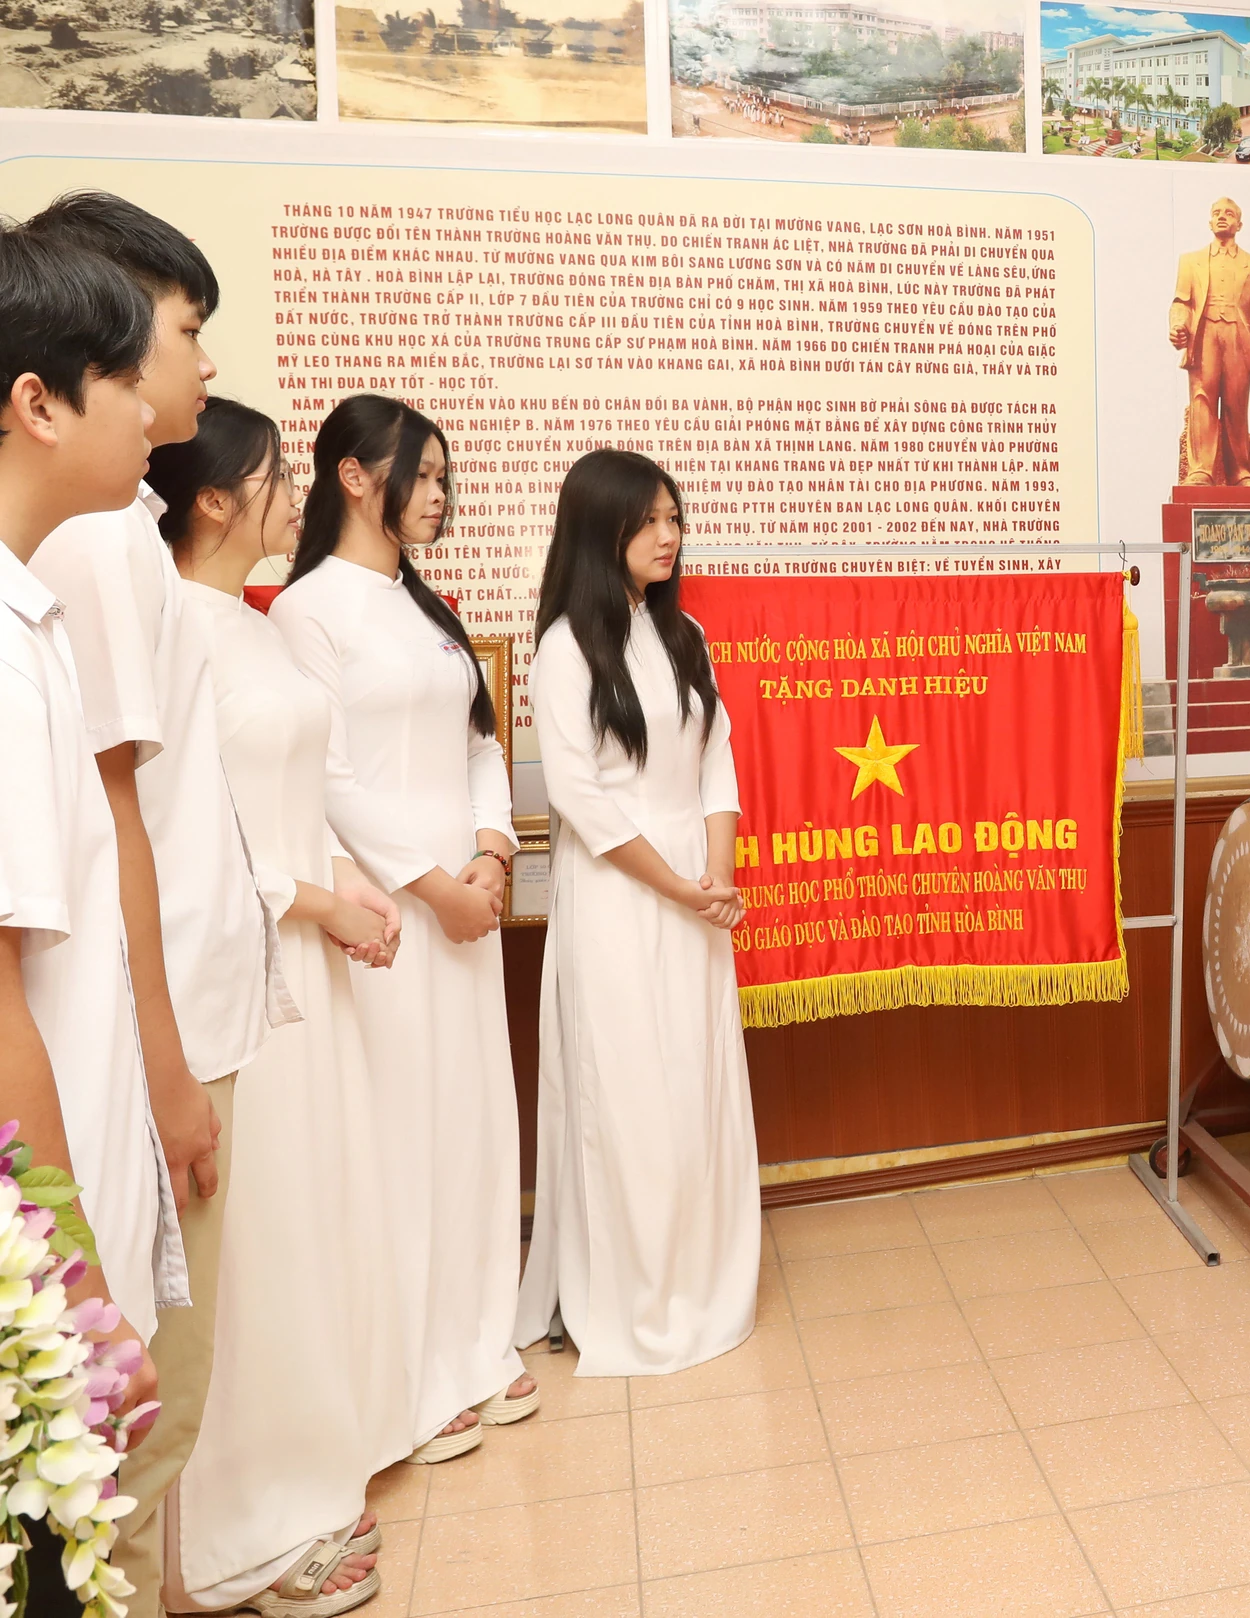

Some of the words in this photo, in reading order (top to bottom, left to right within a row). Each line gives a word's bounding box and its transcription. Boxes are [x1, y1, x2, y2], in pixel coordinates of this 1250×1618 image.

[282, 201, 333, 218] THÁNG
[337, 205, 355, 219] 10
[359, 203, 393, 219] NĂM
[397, 206, 433, 220] 1947
[436, 205, 495, 222] TRƯỜNG
[498, 205, 530, 223] TIỂU
[534, 210, 563, 226] HỌC
[566, 211, 593, 226] LẠC
[597, 212, 634, 226] LONG
[637, 211, 675, 228] QUÂN
[678, 212, 697, 228] ĐÃ
[701, 215, 719, 229] RA
[722, 215, 746, 230] ĐỜI
[749, 217, 771, 233] TẠI
[774, 216, 823, 233] MƯỜNG
[826, 220, 866, 235] VANG,
[869, 222, 894, 237] LẠC
[897, 223, 924, 237] SƠN
[927, 223, 953, 238] HOÀ
[956, 224, 991, 239] BÌNH.
[994, 225, 1023, 241] NĂM
[1026, 229, 1055, 242] 1951
[277, 372, 307, 390] VẪN
[310, 376, 333, 390] THI
[336, 376, 365, 390] ĐUA
[369, 376, 397, 389] DẠY
[400, 372, 425, 390] TỐT
[438, 376, 466, 392] HỌC
[469, 373, 499, 390] TỐT.
[676, 477, 722, 495] NHIỆM
[725, 480, 743, 495] VỤ
[747, 478, 775, 493] ĐÀO
[778, 479, 804, 495] TẠO
[807, 477, 845, 493] NHÂN
[848, 477, 870, 493] TÀI
[874, 479, 900, 493] CHO
[903, 479, 927, 495] ĐỊA
[930, 478, 988, 493] PHƯƠNG.
[991, 478, 1021, 492] NĂM
[1024, 480, 1060, 494] 1993,
[695, 520, 722, 535] VĂN
[725, 521, 756, 537] THỤ.
[759, 518, 777, 534] TỪ
[779, 519, 809, 534] NĂM
[812, 521, 839, 536] HỌC
[842, 521, 872, 534] 2001
[886, 520, 918, 533] 2002
[920, 516, 946, 534] ĐẾN
[949, 520, 979, 534] NAY,
[982, 518, 1009, 533] NHÀ
[1011, 517, 1060, 532] TRƯỜNG
[467, 562, 487, 581] CẢ
[707, 560, 749, 575] RIÊNG
[753, 557, 780, 574] CỦA
[784, 558, 837, 574] TRƯỜNG
[841, 558, 893, 573] CHUYÊN
[897, 558, 931, 572] BIỆT:
[934, 556, 950, 572] VỀ
[953, 555, 995, 572] TUYỂN
[998, 559, 1034, 571] SINH,
[1037, 556, 1062, 571] XÂY
[710, 641, 733, 664] CH
[736, 634, 781, 664] NƯỚC
[785, 633, 830, 665] CỘNG
[832, 632, 868, 660] HÒA
[870, 630, 892, 659] XÃ
[895, 629, 925, 661] HỘI
[927, 626, 961, 657] CHỦ
[964, 627, 1013, 655] NGHĨA
[1015, 625, 1052, 657] VIỆT
[1054, 631, 1087, 654] NAM
[759, 675, 834, 706] TẶNG
[840, 676, 919, 698] DANH
[923, 667, 989, 699] HIỆU
[735, 835, 760, 869] H
[771, 821, 879, 866] HÙNG
[891, 821, 963, 856] LAO
[973, 811, 1078, 859] ĐỘNG
[787, 879, 820, 905] HỌC
[822, 870, 855, 901] PHỔ
[856, 868, 909, 899] THÔNG
[911, 865, 971, 896] CHUYÊN
[973, 863, 1024, 893] HOÀNG
[1025, 865, 1056, 891] VĂN
[1058, 868, 1088, 895] THỤ
[731, 920, 751, 954] SỞ
[754, 917, 792, 951] GIÁO
[793, 920, 826, 949] DỤC
[827, 911, 850, 941] VÀ
[849, 909, 881, 940] ĐÀO
[883, 912, 914, 937] TẠO
[916, 905, 952, 935] TỈNH
[953, 903, 985, 933] HÒA
[986, 903, 1025, 932] BÌNH
